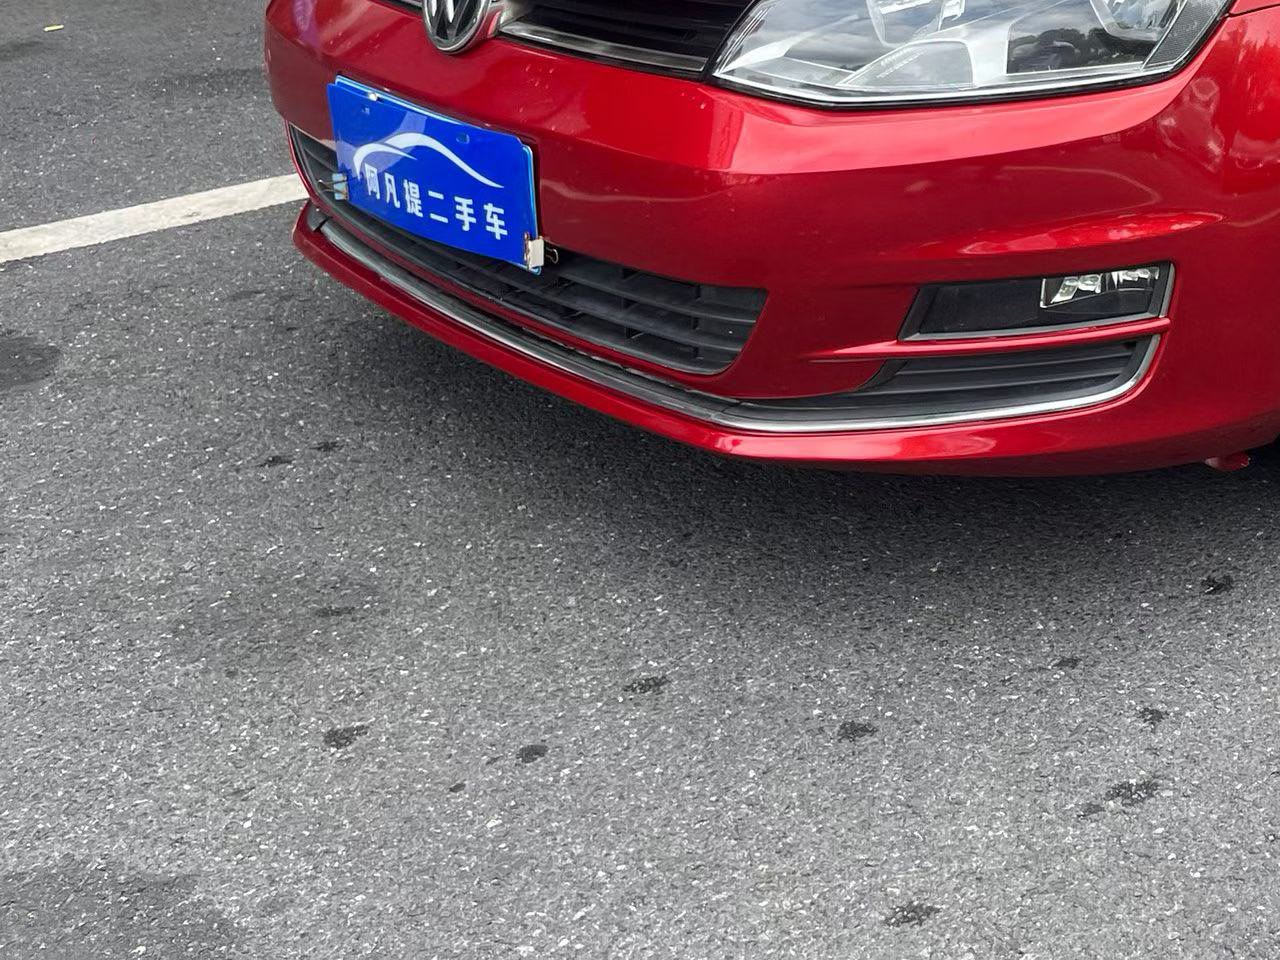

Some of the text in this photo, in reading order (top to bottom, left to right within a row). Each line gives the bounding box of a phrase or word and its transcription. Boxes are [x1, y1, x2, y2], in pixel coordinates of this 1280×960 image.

[364, 161, 509, 240] 阿凡提二手车
